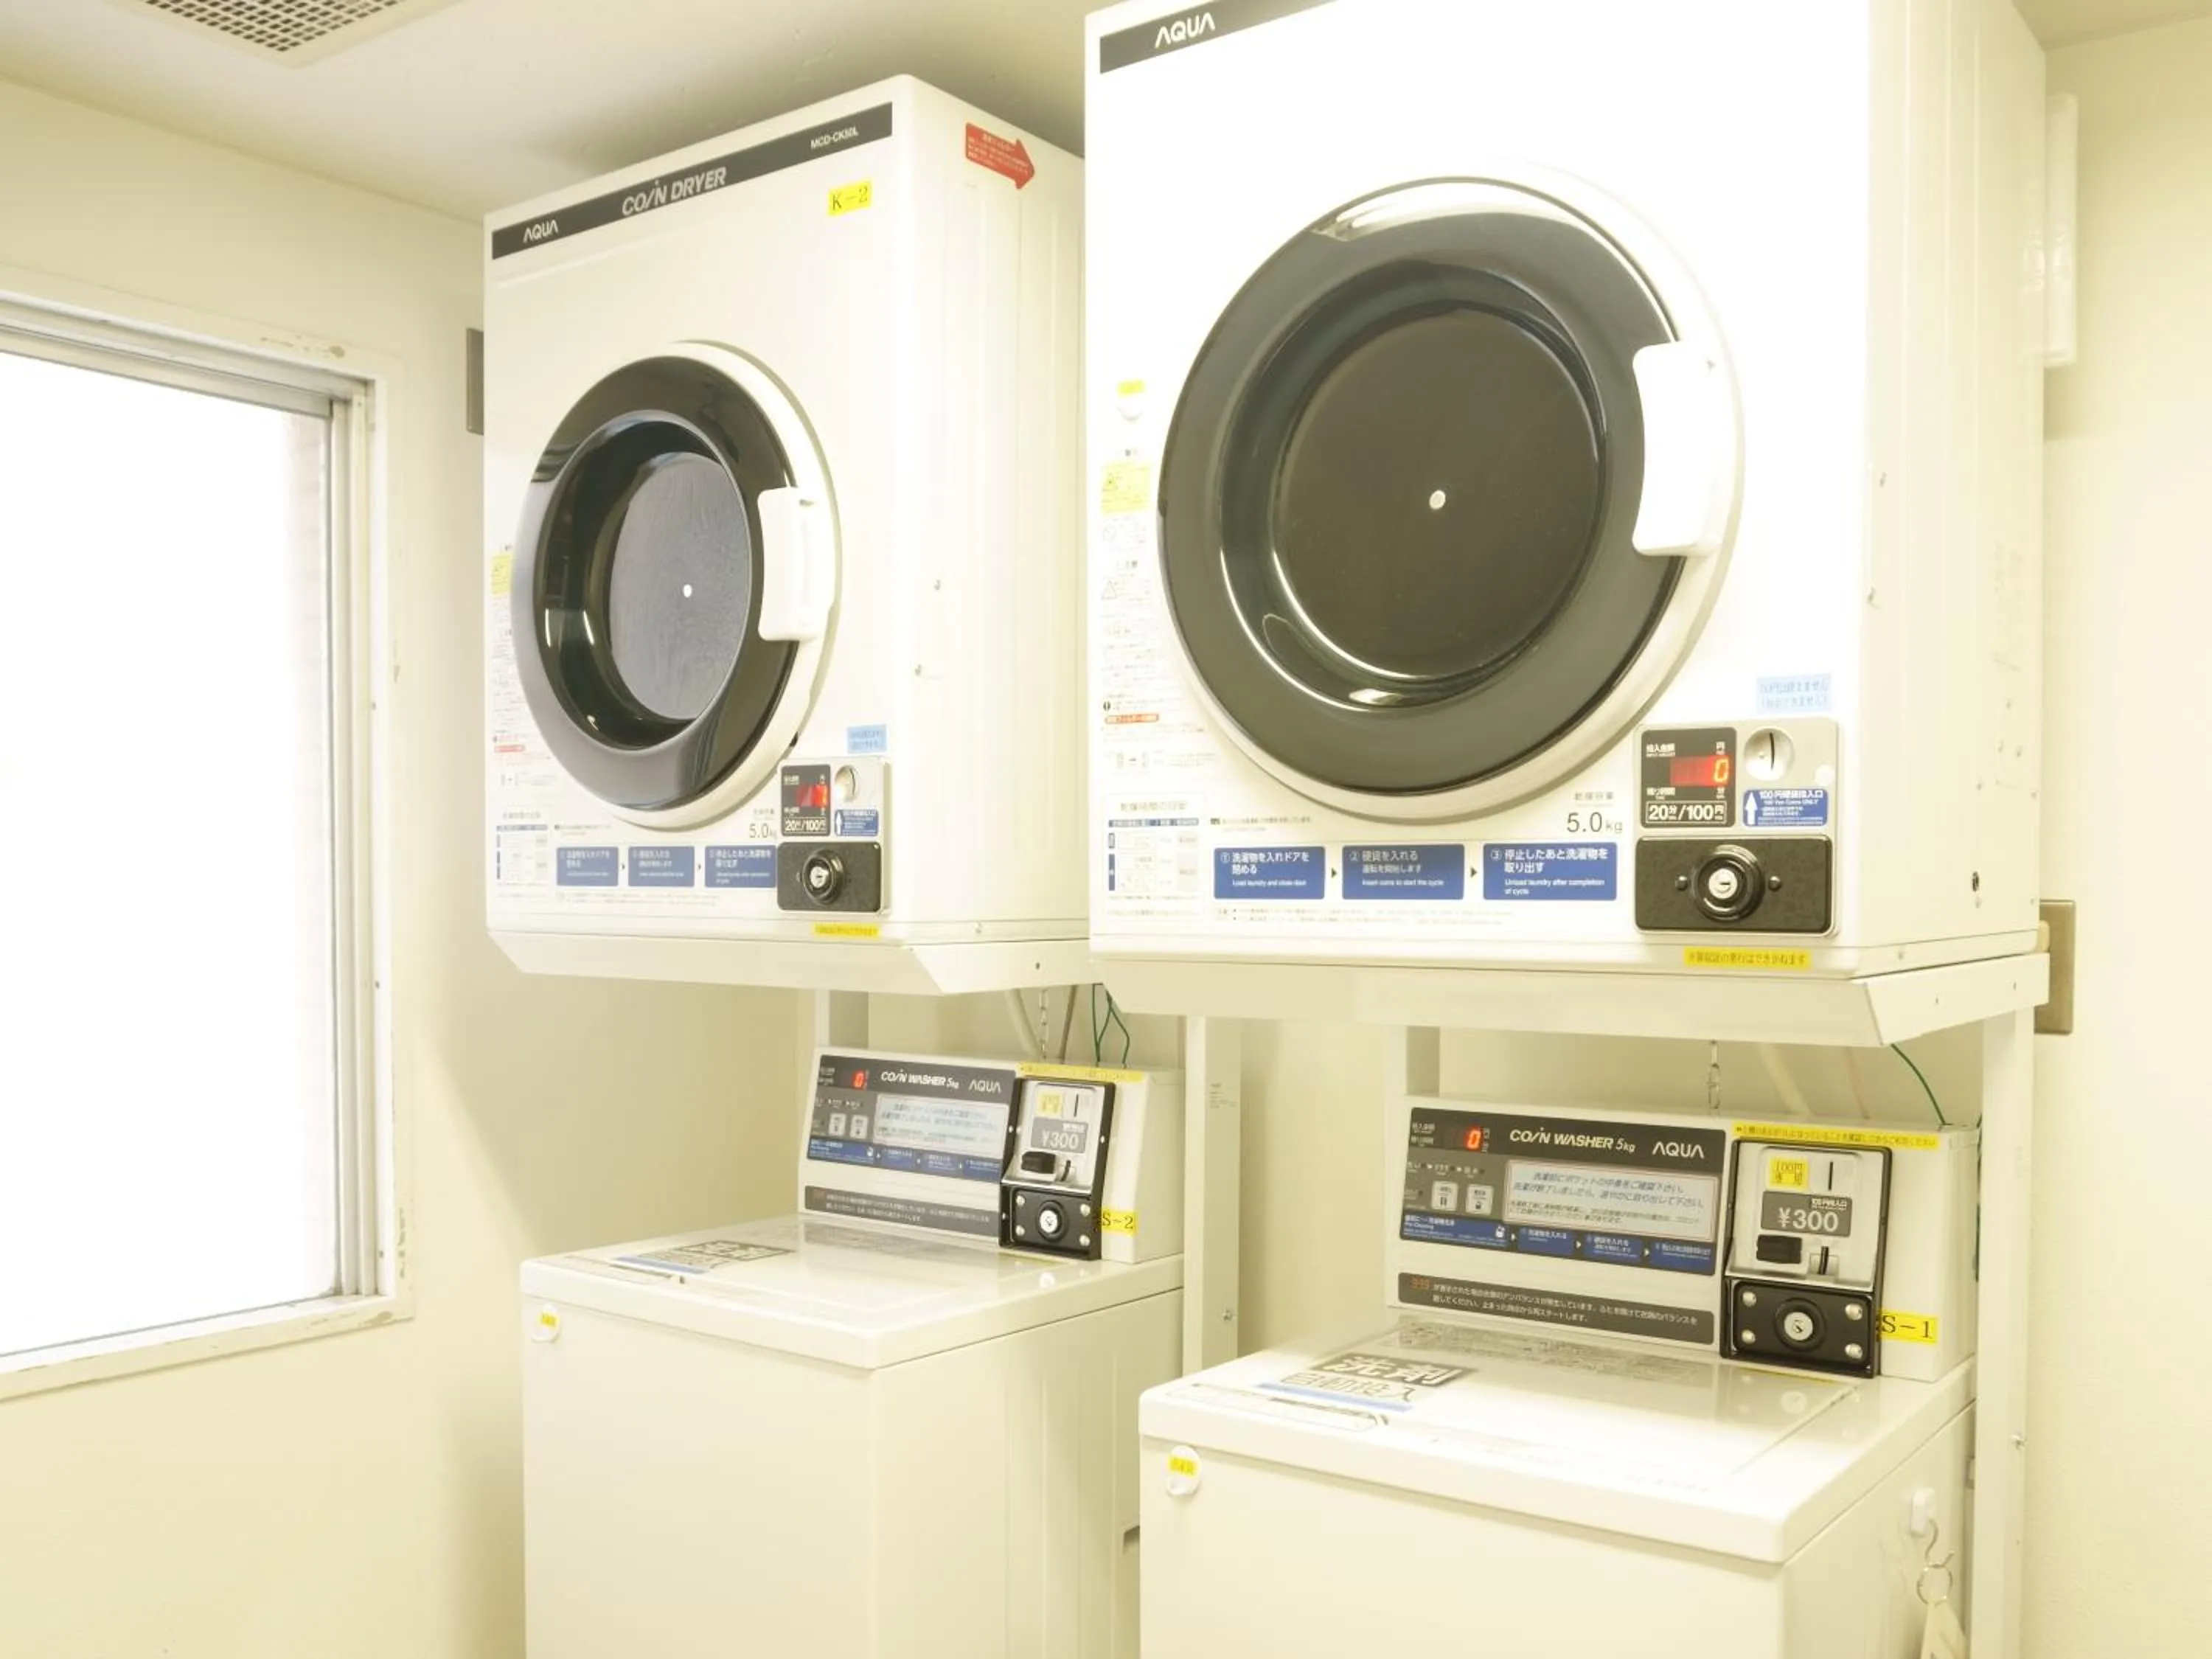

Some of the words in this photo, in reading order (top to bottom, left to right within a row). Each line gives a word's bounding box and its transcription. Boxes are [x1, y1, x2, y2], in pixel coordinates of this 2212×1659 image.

[1155, 12, 1215, 48] AQUA
[523, 220, 558, 243] AQUA
[670, 166, 727, 200] DRYER
[1713, 758, 1730, 784] 0
[1504, 861, 1545, 874] 取り出す
[854, 1071, 865, 1088] 0
[908, 1073, 947, 1086] WASHER
[968, 1079, 1001, 1094] AQUA
[1041, 1129, 1079, 1150] ¥300
[1467, 1130, 1481, 1150] 0
[1554, 1133, 1614, 1150] WASHER
[1615, 1138, 1635, 1154] 5kg
[1652, 1141, 1705, 1159] AQUA
[1777, 1207, 1839, 1233] ¥300
[1881, 1315, 1933, 1339] S-1
[1323, 1355, 1464, 1385] 洗剤
